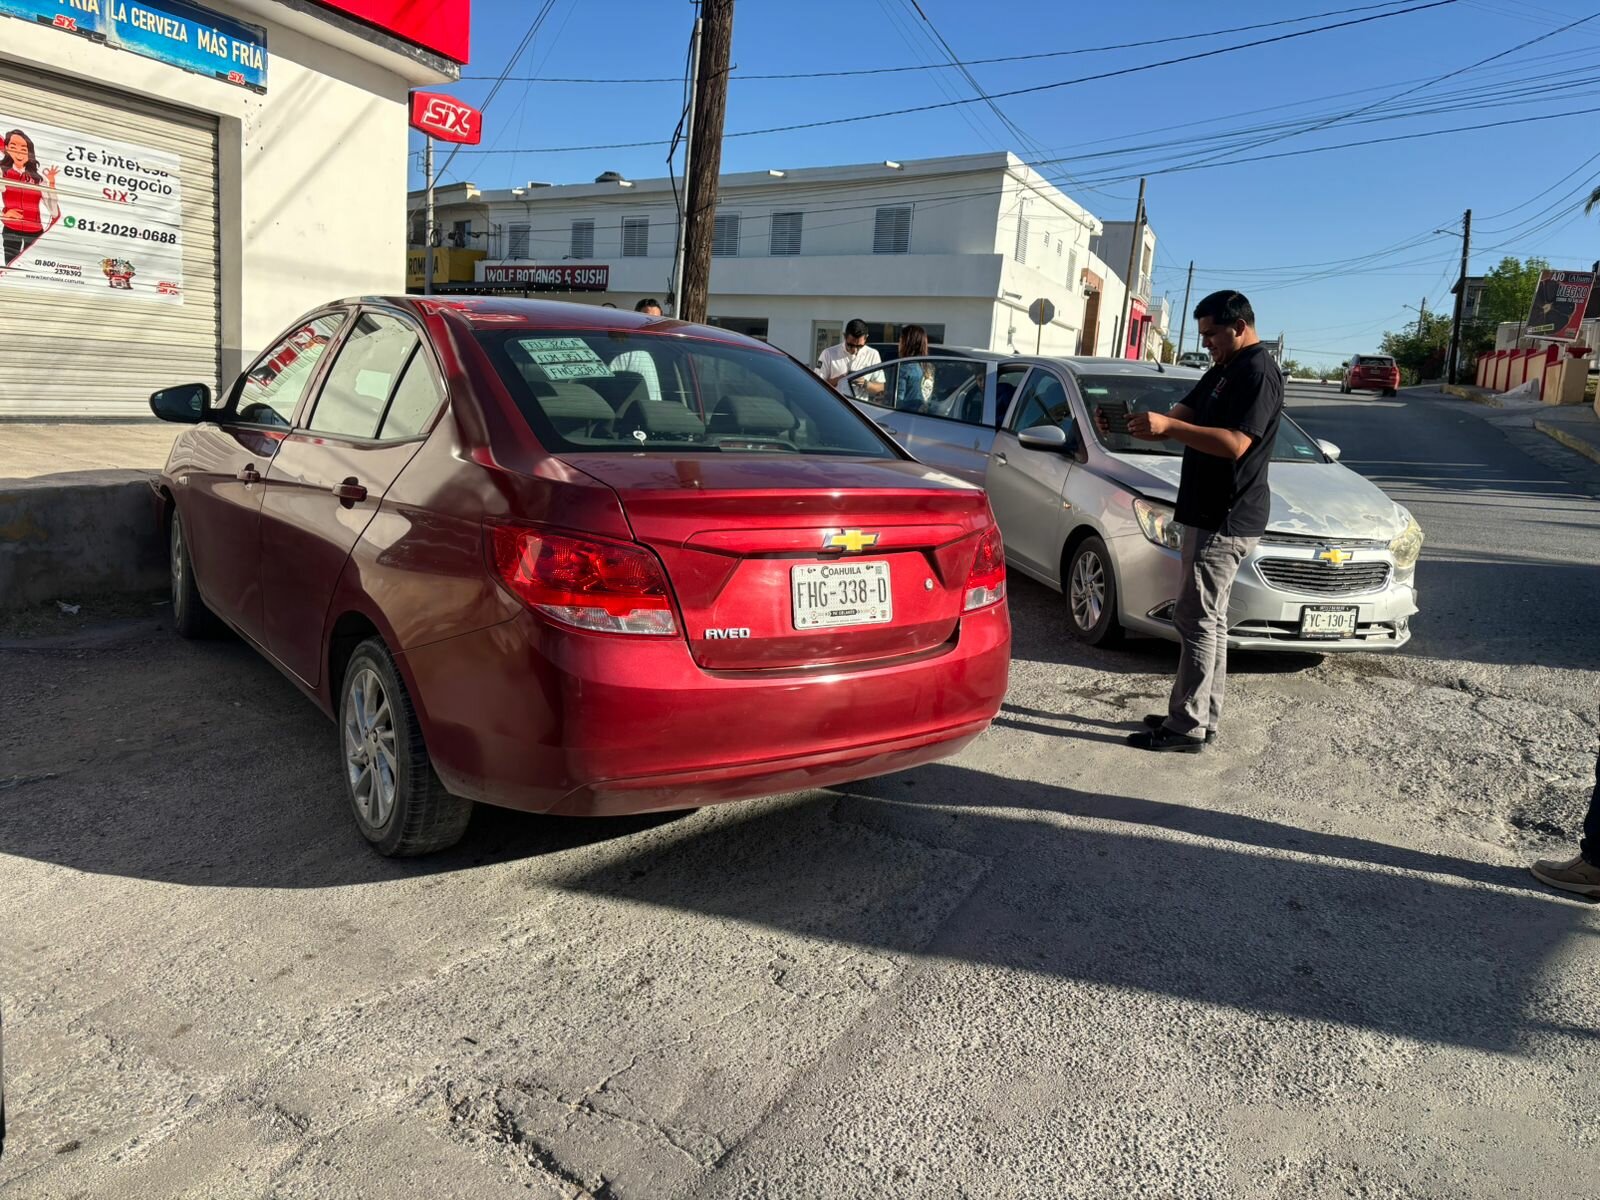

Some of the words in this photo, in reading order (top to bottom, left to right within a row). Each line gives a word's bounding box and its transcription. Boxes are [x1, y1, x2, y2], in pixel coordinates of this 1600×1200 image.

[110, 0, 127, 24] LA
[131, 10, 188, 43] CERVEZA
[198, 27, 228, 59] MÁS
[232, 41, 263, 71] FRÍA
[421, 98, 471, 136] SIX
[66, 145, 97, 162] ¿Te
[64, 165, 101, 181] este
[106, 173, 172, 195] negocio
[486, 268, 514, 282] WOLF
[516, 268, 562, 284] BOTANAS
[564, 269, 572, 284] &
[574, 269, 607, 284] SUSHI
[797, 577, 887, 608] FHG-338-D
[1303, 614, 1356, 628] FYC-130-E
[704, 627, 751, 640] AVEO
